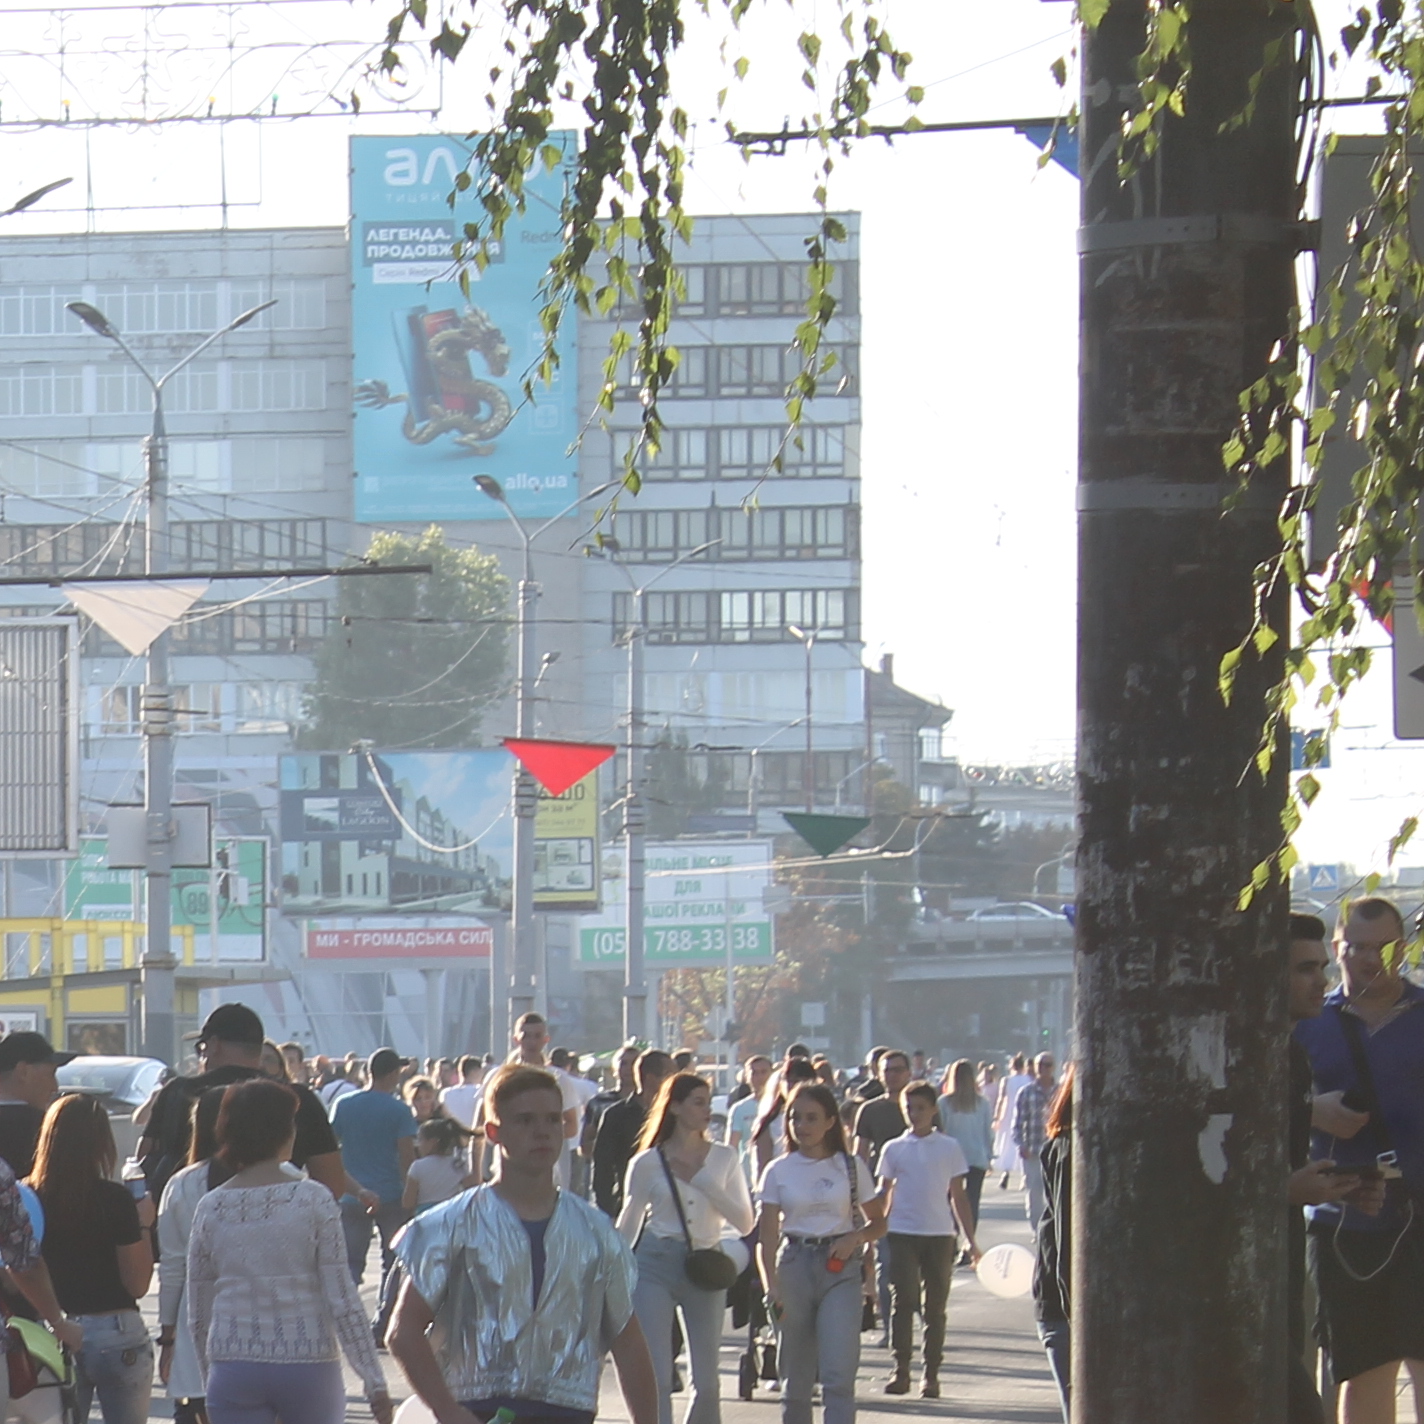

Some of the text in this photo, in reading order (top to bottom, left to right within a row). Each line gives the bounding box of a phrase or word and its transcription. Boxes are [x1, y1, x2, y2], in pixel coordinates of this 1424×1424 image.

[675, 880, 702, 896] ДЛЯ
[316, 933, 338, 948] МИ
[352, 930, 456, 949] ГРОМАДСЬКА
